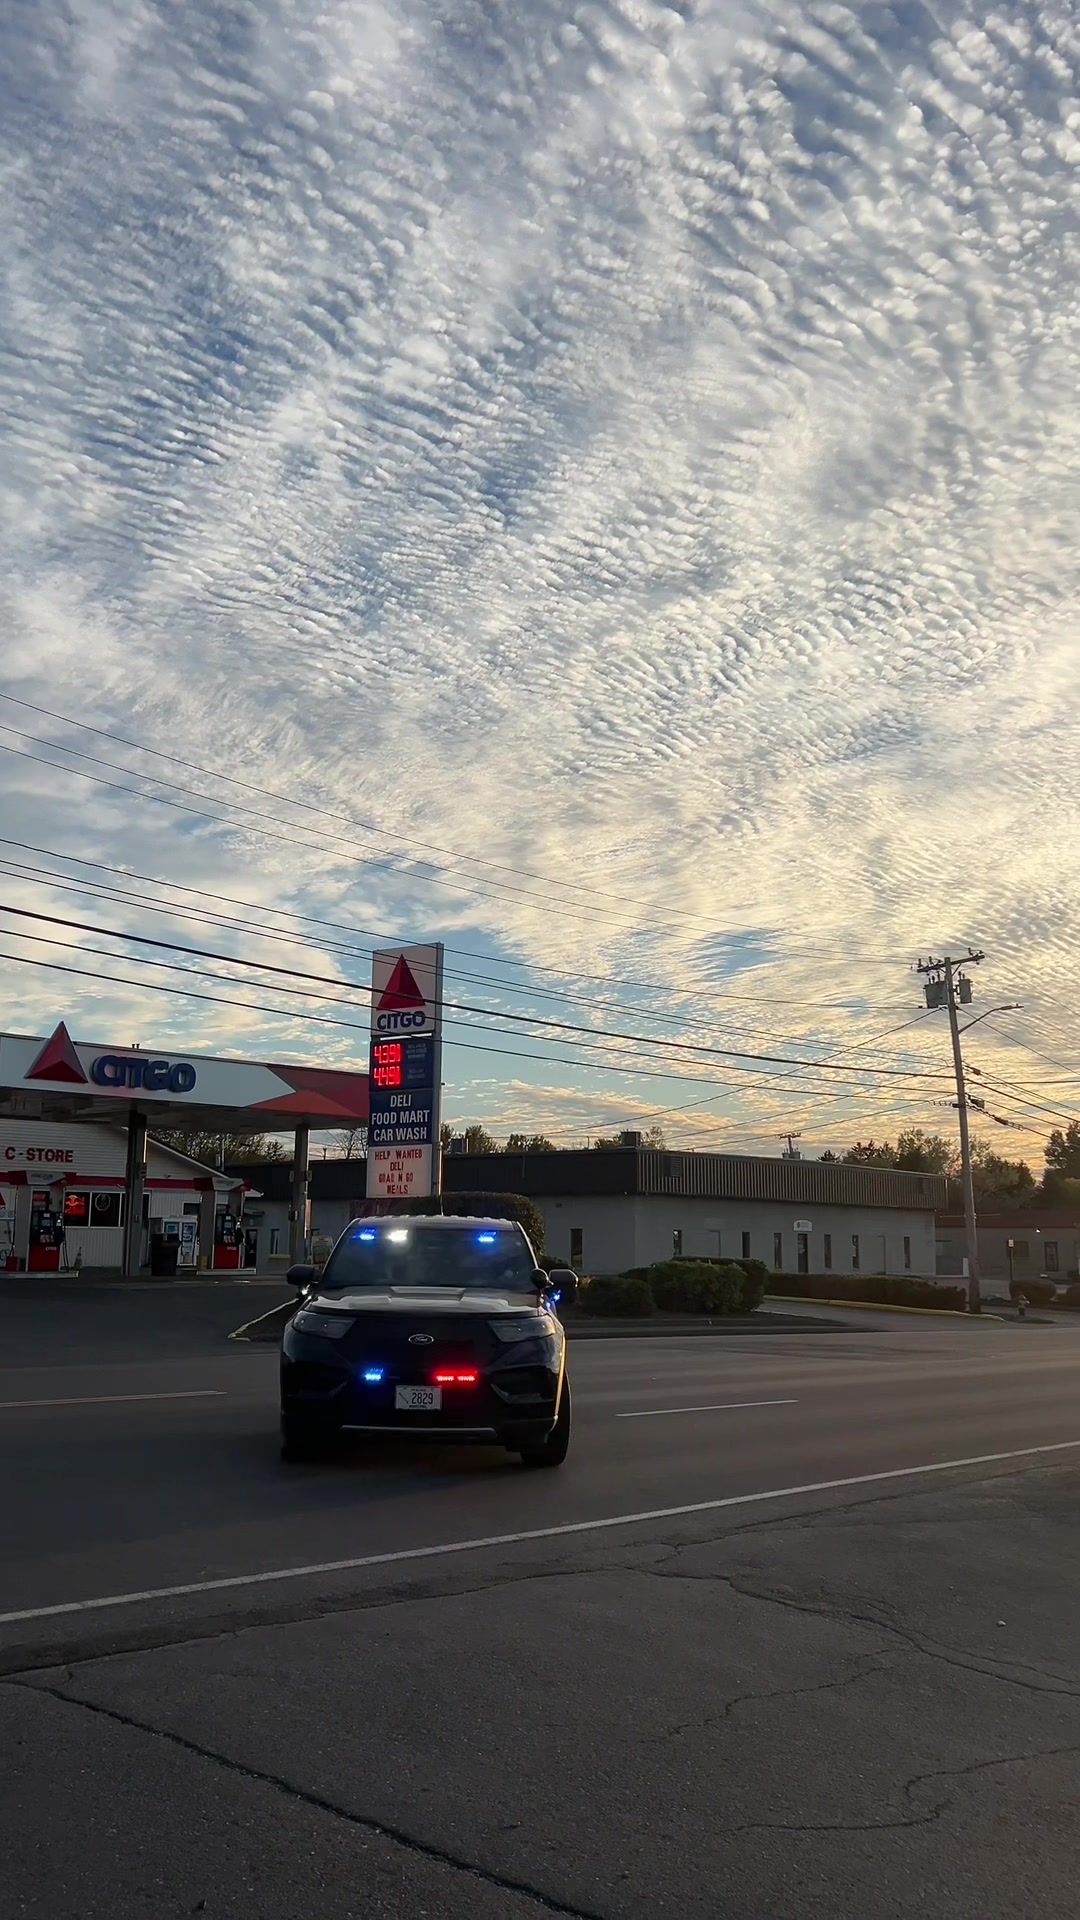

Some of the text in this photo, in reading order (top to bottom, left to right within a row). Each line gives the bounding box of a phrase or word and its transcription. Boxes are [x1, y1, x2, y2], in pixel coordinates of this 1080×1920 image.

[377, 1011, 426, 1029] CITGO
[92, 1055, 197, 1093] CITGO
[390, 1094, 412, 1107] DELI
[371, 1110, 430, 1125] FOOD MART
[374, 1127, 427, 1142] CAR WASH
[374, 1149, 422, 1160] HELP WANTED
[390, 1162, 404, 1171] DELI
[412, 1392, 434, 1404] 2829
